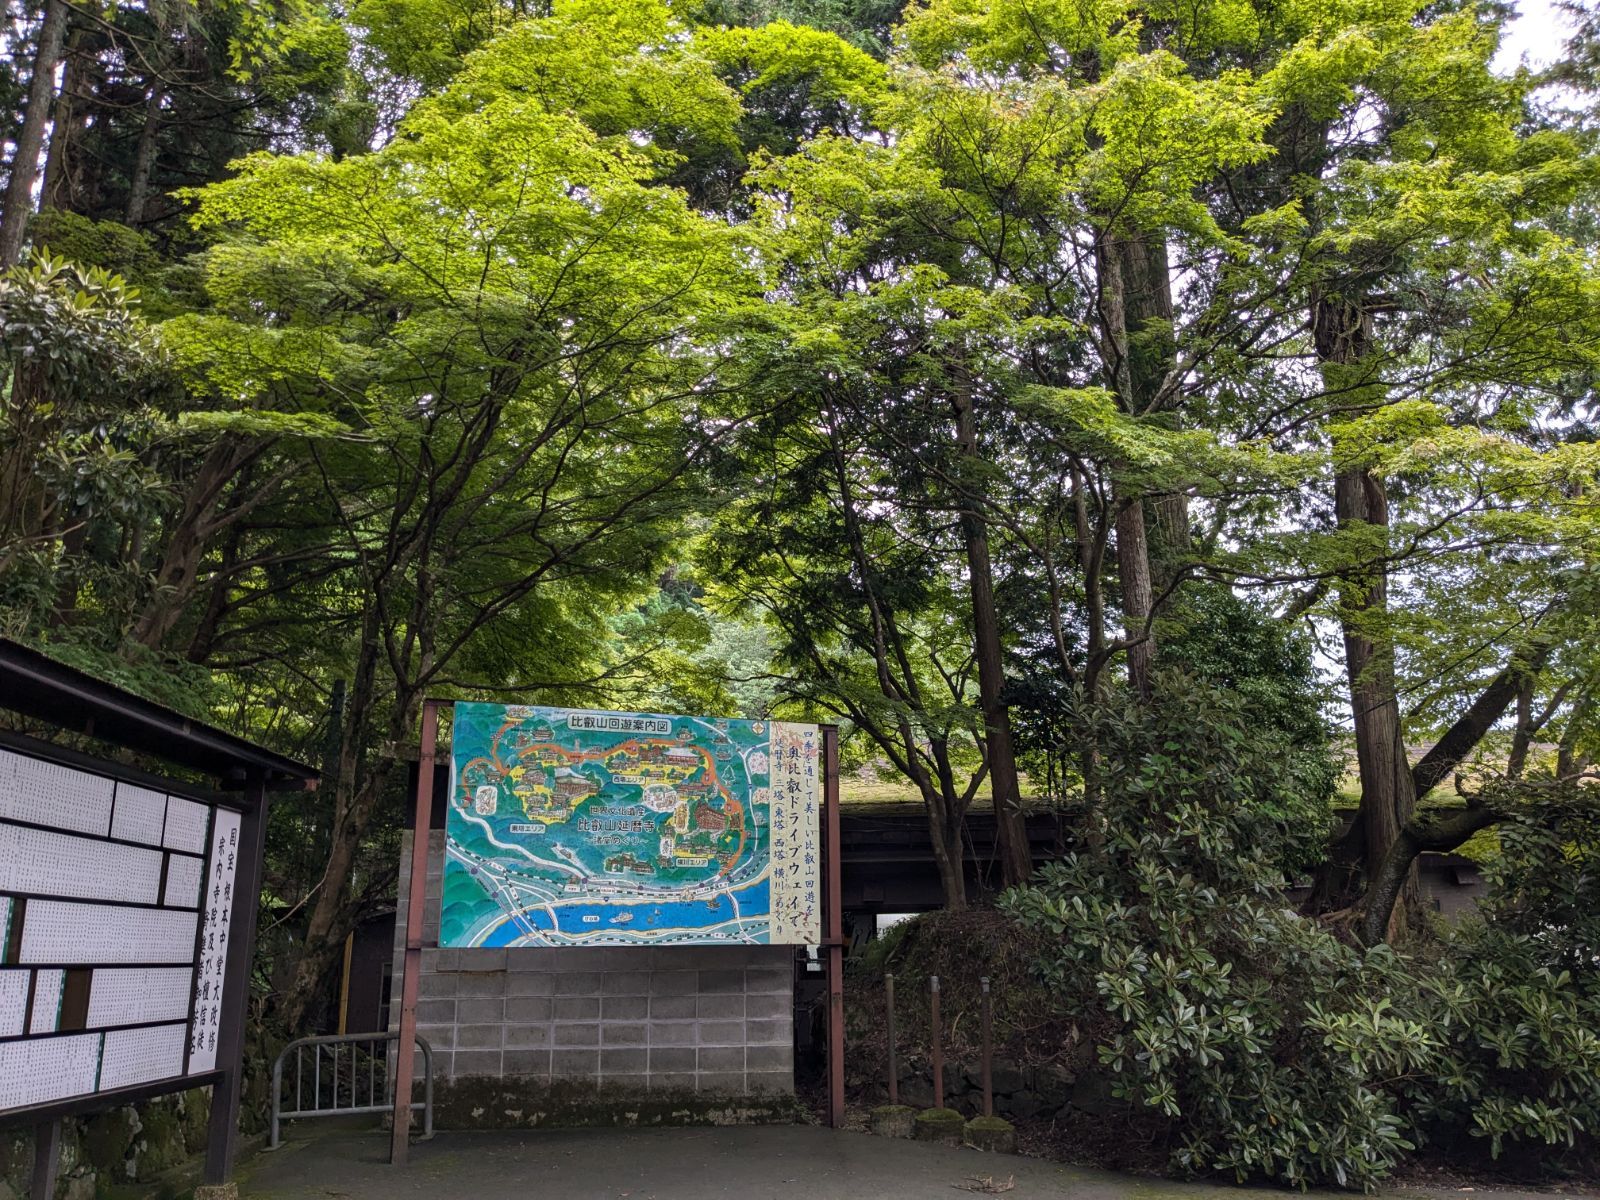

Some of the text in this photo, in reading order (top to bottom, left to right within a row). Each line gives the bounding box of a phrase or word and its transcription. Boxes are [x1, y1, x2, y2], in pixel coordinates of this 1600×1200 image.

[571, 715, 668, 732] 比叡山回遊案内図
[578, 818, 655, 832] 比叡山延暦寺
[786, 745, 802, 928] 奥比叡ドライブウェイで
